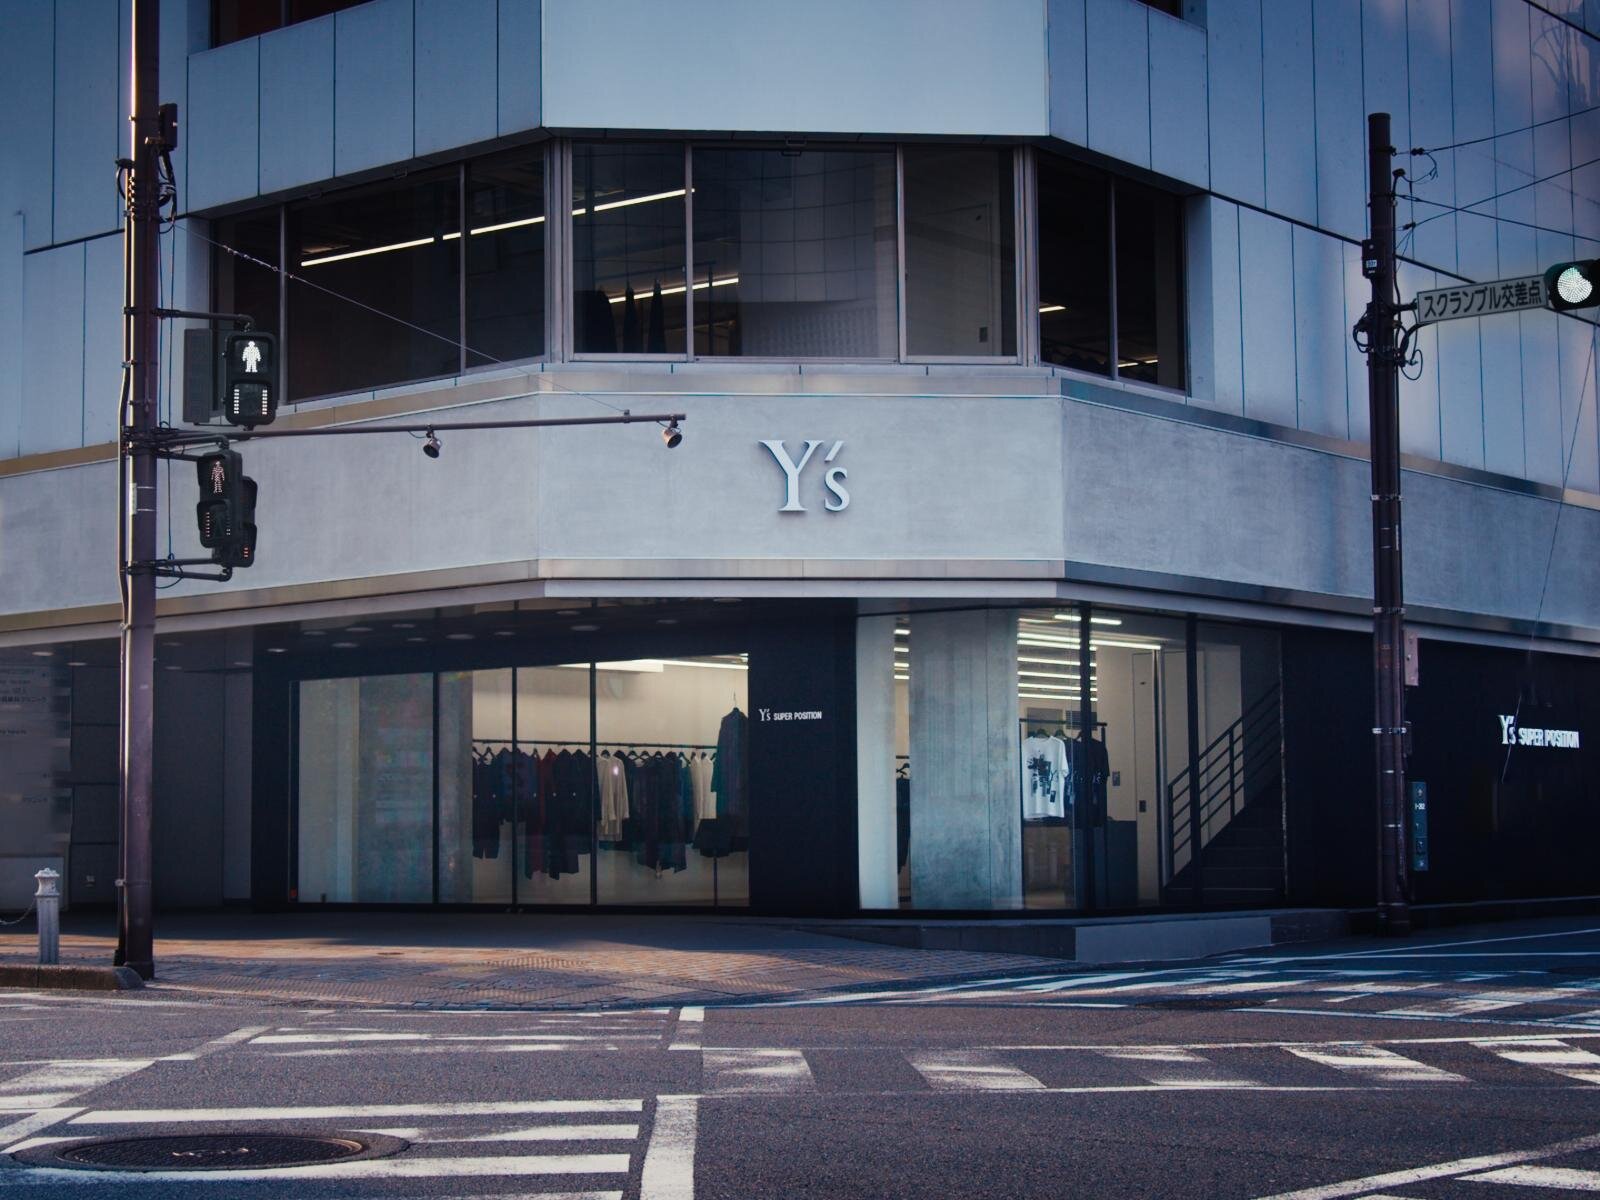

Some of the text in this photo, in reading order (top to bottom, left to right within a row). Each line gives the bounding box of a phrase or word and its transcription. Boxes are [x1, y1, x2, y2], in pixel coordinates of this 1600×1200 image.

[1424, 280, 1541, 318] スクランブル交差点
[757, 439, 850, 512] Y's
[759, 708, 822, 721] Y's SUPER POSITION
[1498, 715, 1579, 748] Y's SUPER POSITION
